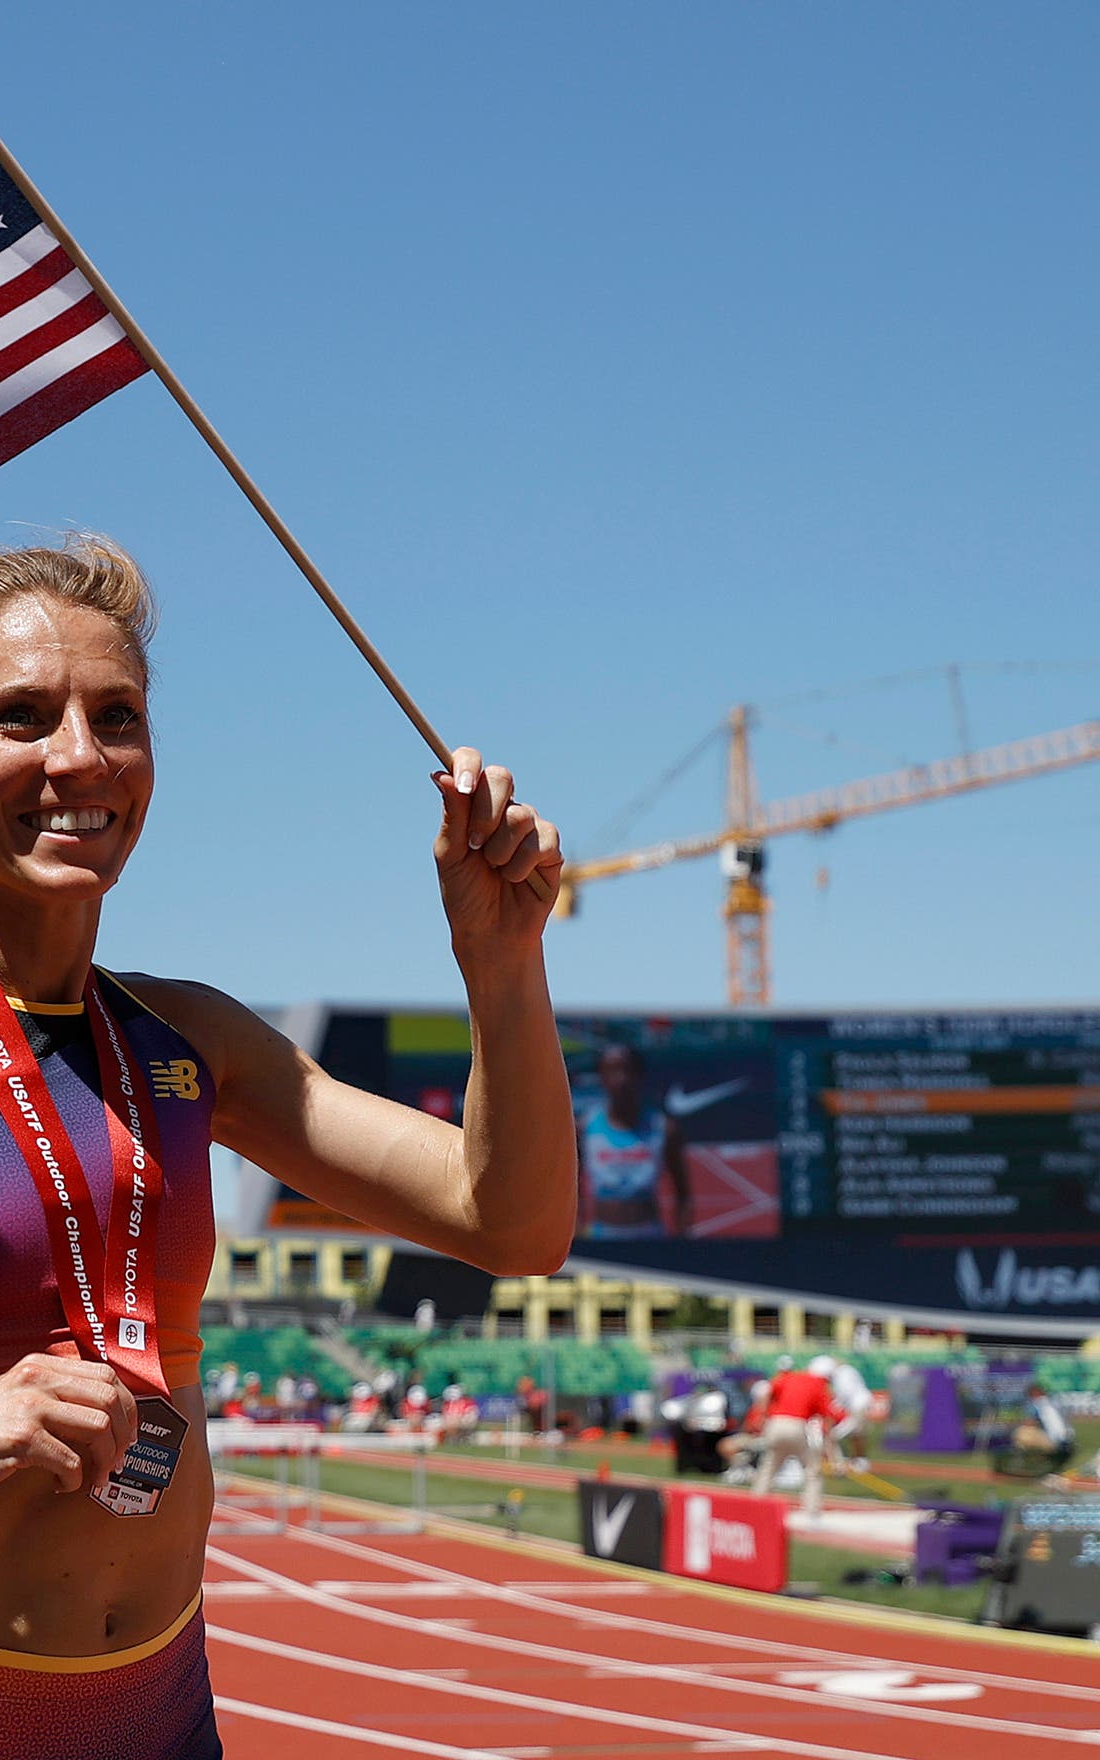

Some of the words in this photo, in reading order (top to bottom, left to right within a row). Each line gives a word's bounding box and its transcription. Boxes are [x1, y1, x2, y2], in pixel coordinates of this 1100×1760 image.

[7, 1076, 45, 1133] USATF
[36, 1137, 72, 1211] Outdoor
[127, 1099, 146, 1170] Outdoor
[128, 1173, 147, 1238] USATF
[124, 1248, 138, 1314] TOYOTA
[140, 1421, 171, 1438] USATF
[123, 1454, 171, 1480] PIONSHIPS
[132, 1443, 169, 1462] OUTDOOR
[120, 1491, 143, 1504] TOYOTA
